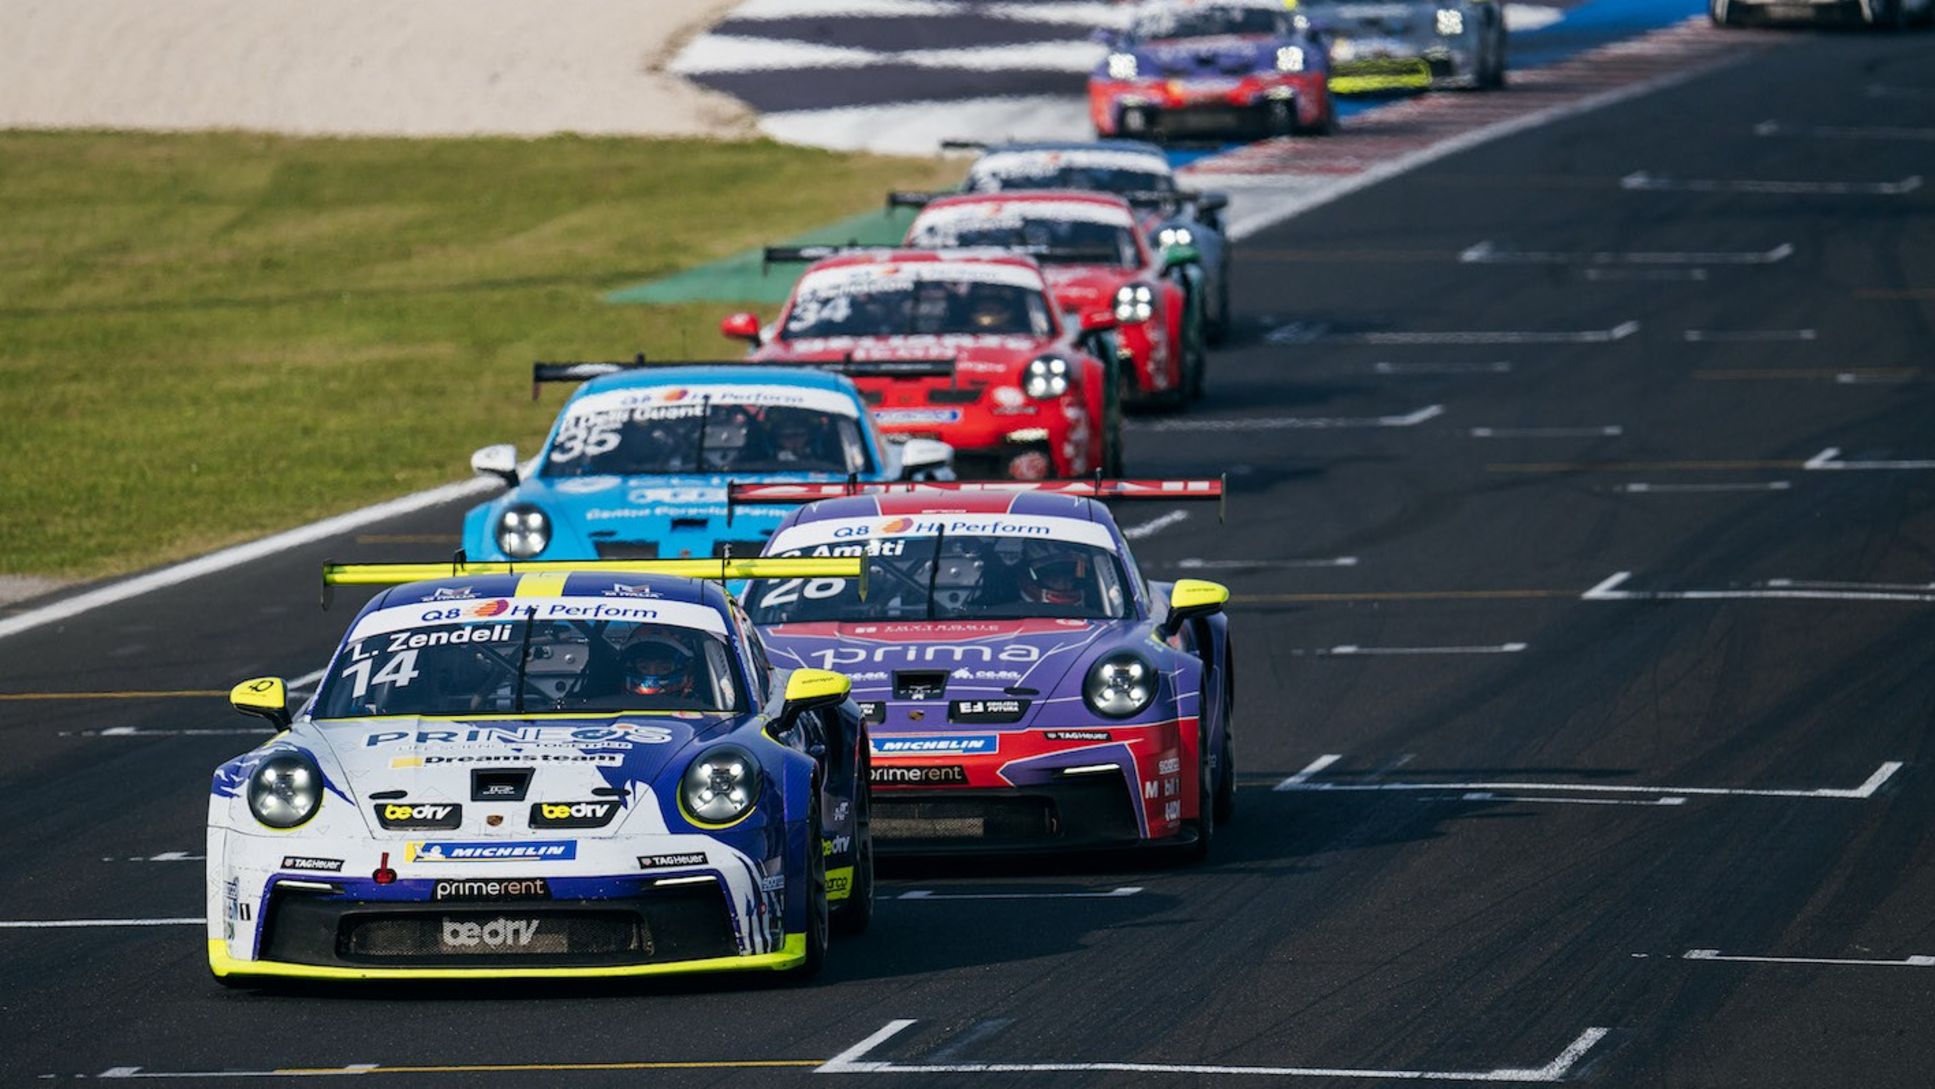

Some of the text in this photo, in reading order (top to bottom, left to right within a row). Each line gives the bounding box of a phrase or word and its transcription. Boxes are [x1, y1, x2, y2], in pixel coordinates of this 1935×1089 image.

[550, 427, 622, 463] 35
[834, 526, 869, 538] Q8
[951, 521, 1050, 535] Perform
[421, 607, 461, 622] Q8
[549, 603, 657, 619] Perform
[352, 625, 513, 661] L. Zendeli
[342, 649, 419, 698] 14
[882, 740, 985, 751] MICHELIN
[451, 845, 566, 858] MICHELIN
[437, 879, 544, 899] primerent
